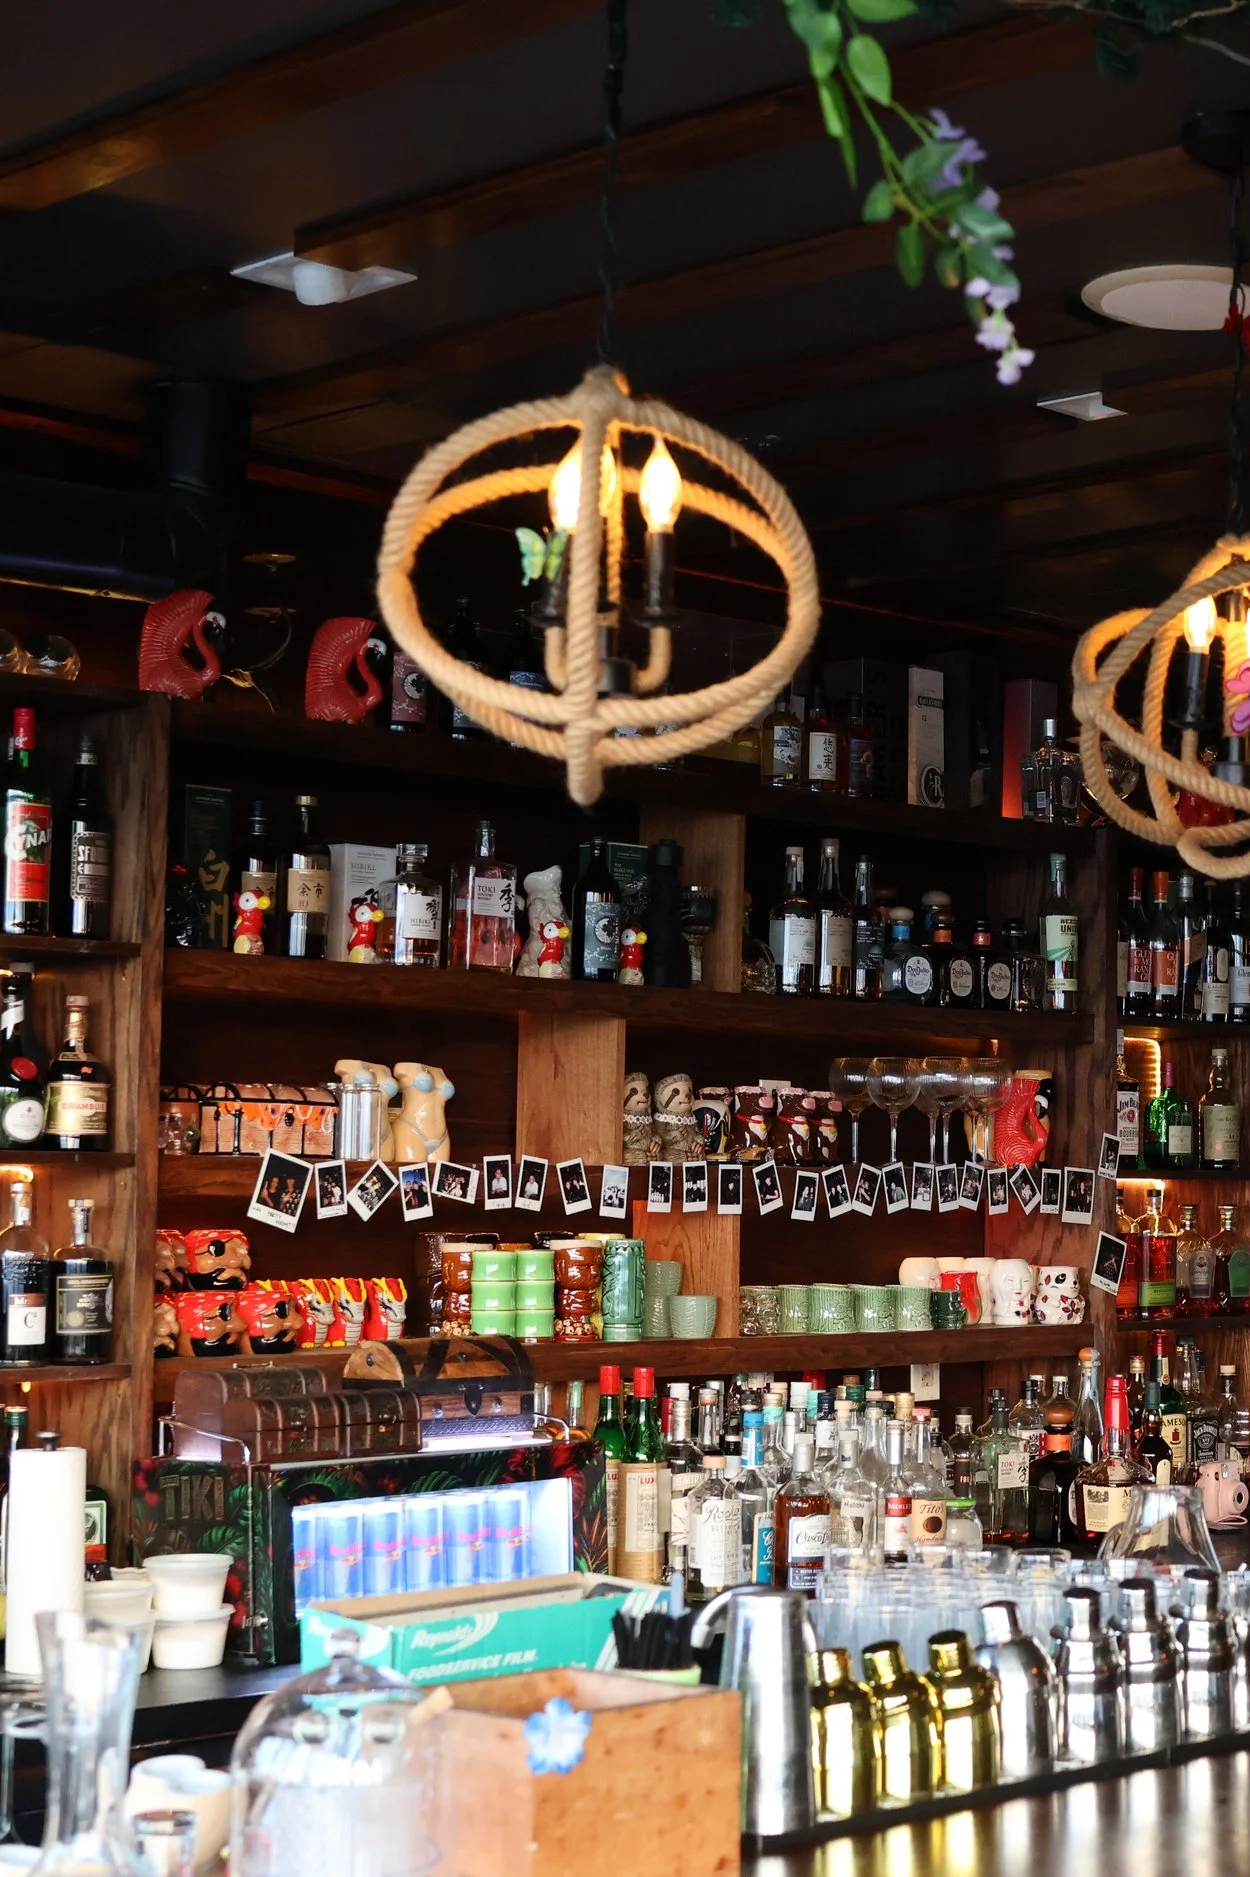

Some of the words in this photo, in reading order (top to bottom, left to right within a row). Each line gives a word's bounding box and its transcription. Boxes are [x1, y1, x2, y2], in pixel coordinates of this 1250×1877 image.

[477, 885, 496, 894] TOKI
[1001, 1461, 1015, 1469] TOKI
[159, 1474, 225, 1521] TIKI
[919, 1503, 945, 1515] Tito's
[410, 1621, 477, 1650] Reynolds
[405, 1653, 503, 1681] FOODSERVICE
[503, 1648, 538, 1665] FILM
